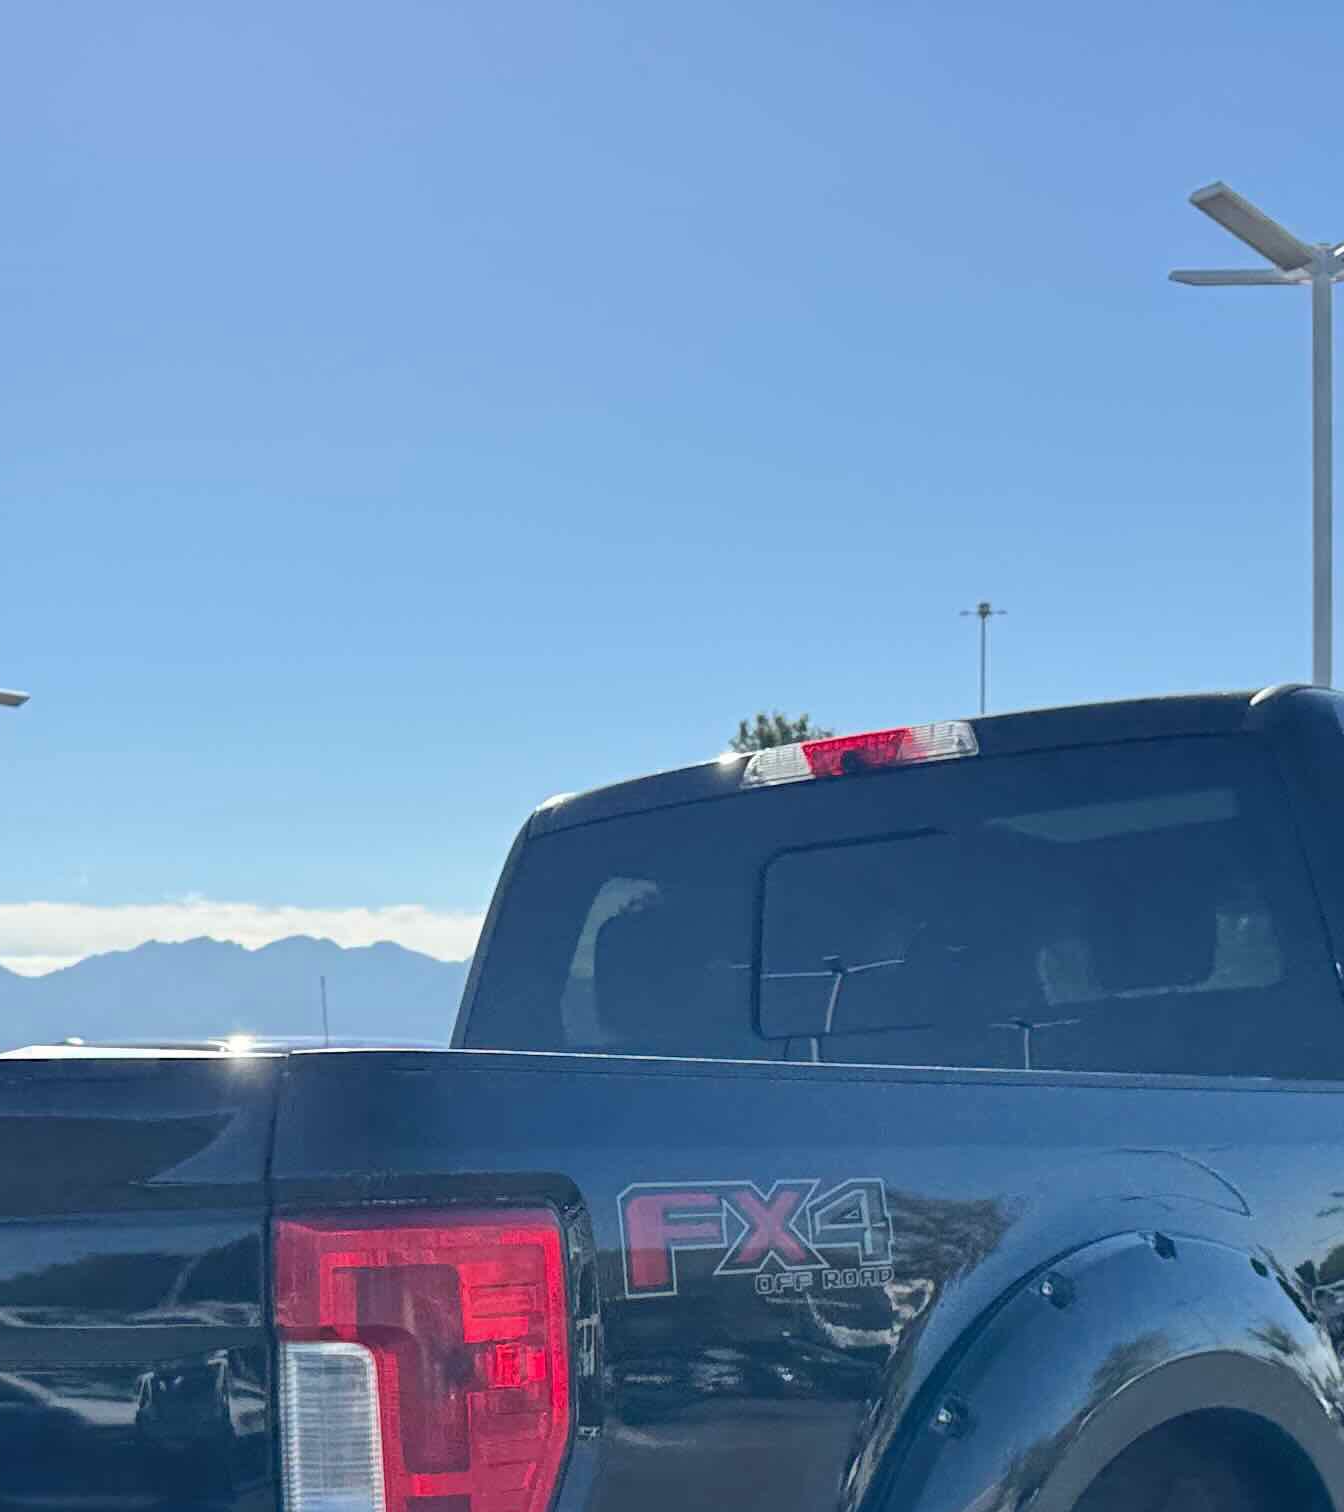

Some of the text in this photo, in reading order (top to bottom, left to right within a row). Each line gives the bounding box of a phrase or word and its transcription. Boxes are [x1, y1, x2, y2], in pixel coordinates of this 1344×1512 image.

[616, 1177, 894, 1299] FX4
[754, 1266, 895, 1295] OFF ROAD
